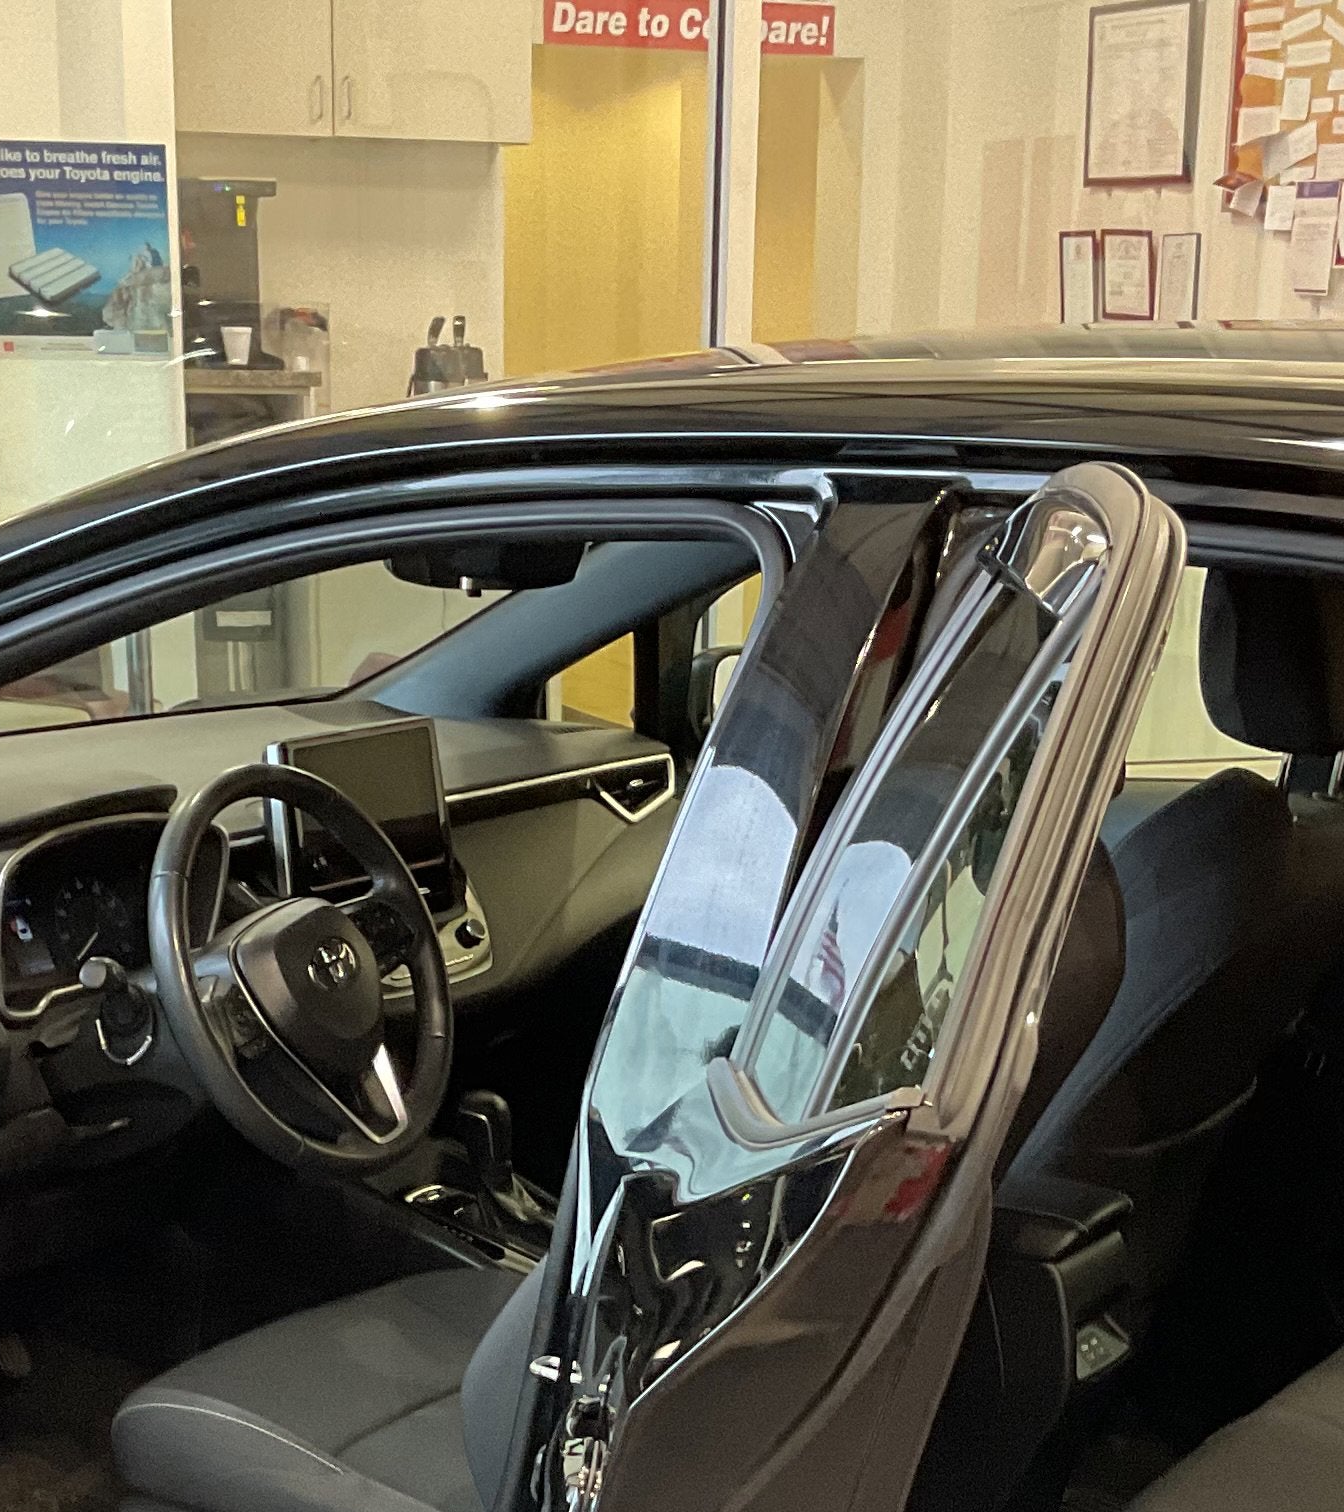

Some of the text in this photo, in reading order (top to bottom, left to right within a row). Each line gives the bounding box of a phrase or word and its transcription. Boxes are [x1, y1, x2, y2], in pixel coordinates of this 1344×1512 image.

[552, 2, 830, 47] Dare to Care!
[26, 150, 41, 163] to
[44, 150, 98, 164] breathe
[102, 151, 137, 165] fresh
[141, 152, 162, 166] air.
[28, 168, 62, 182] your
[63, 167, 111, 183] Toyota
[113, 169, 165, 185] engine.
